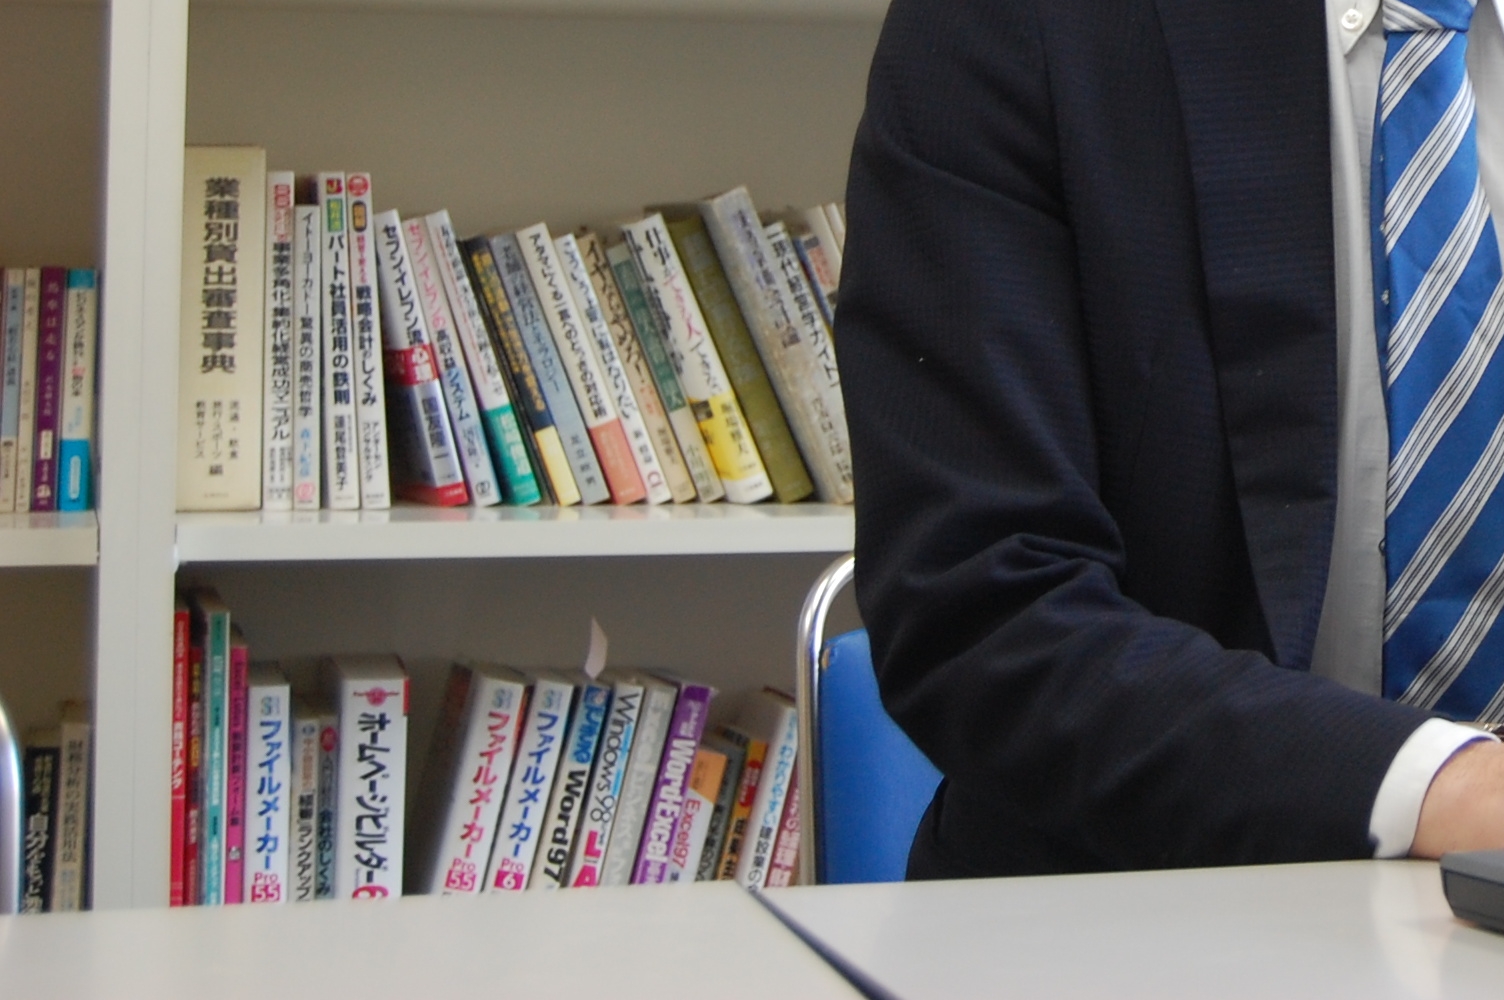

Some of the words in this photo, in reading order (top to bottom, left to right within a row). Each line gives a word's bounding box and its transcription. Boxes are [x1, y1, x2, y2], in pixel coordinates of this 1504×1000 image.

[255, 720, 283, 871] ファイルメーカー
[460, 710, 510, 859] ファイルメーカー
[508, 711, 559, 857] ファイルメーカー
[254, 871, 279, 884] Pro
[452, 859, 477, 873] Pro
[500, 858, 525, 872] Pro
